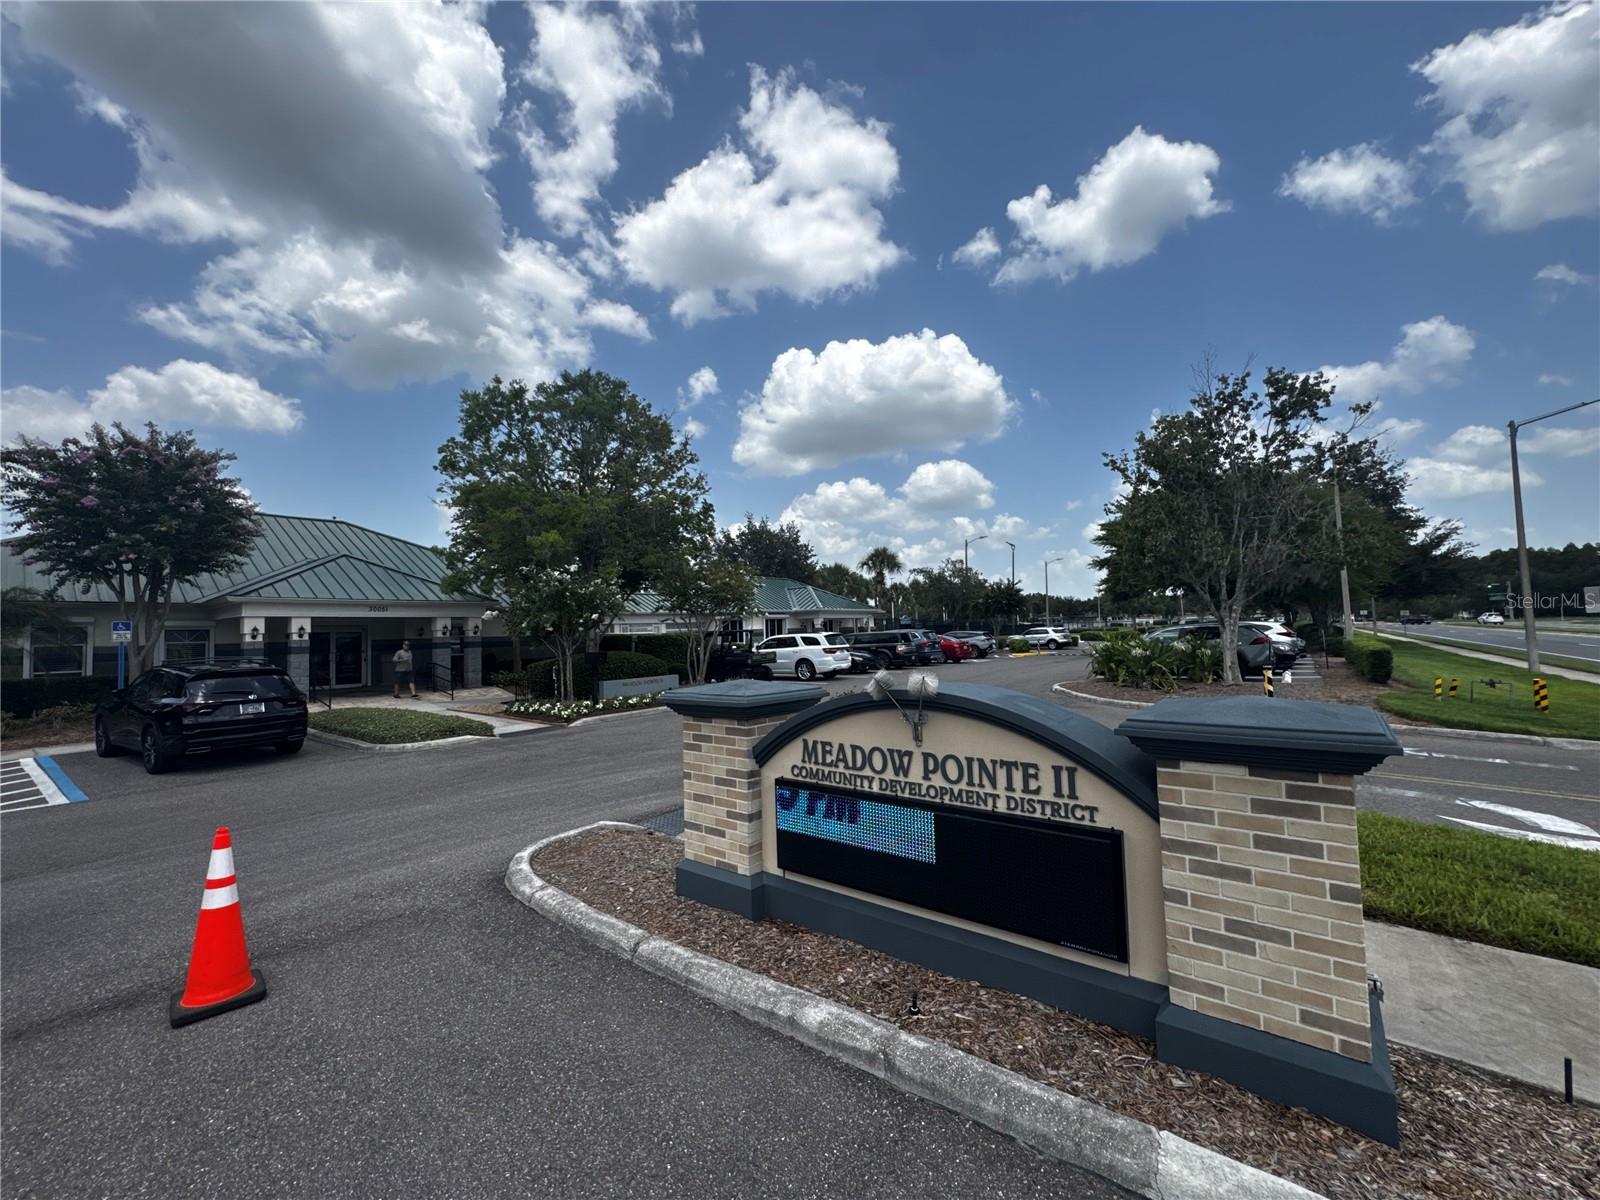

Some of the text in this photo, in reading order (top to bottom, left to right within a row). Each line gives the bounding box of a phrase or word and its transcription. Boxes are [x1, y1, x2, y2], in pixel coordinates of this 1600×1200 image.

[791, 764, 875, 790] COMMUNITY
[878, 777, 1001, 810] DEVELOPMENT
[1005, 795, 1099, 823] DISTRICT
[801, 738, 1079, 801] MEADOW POINTE II
